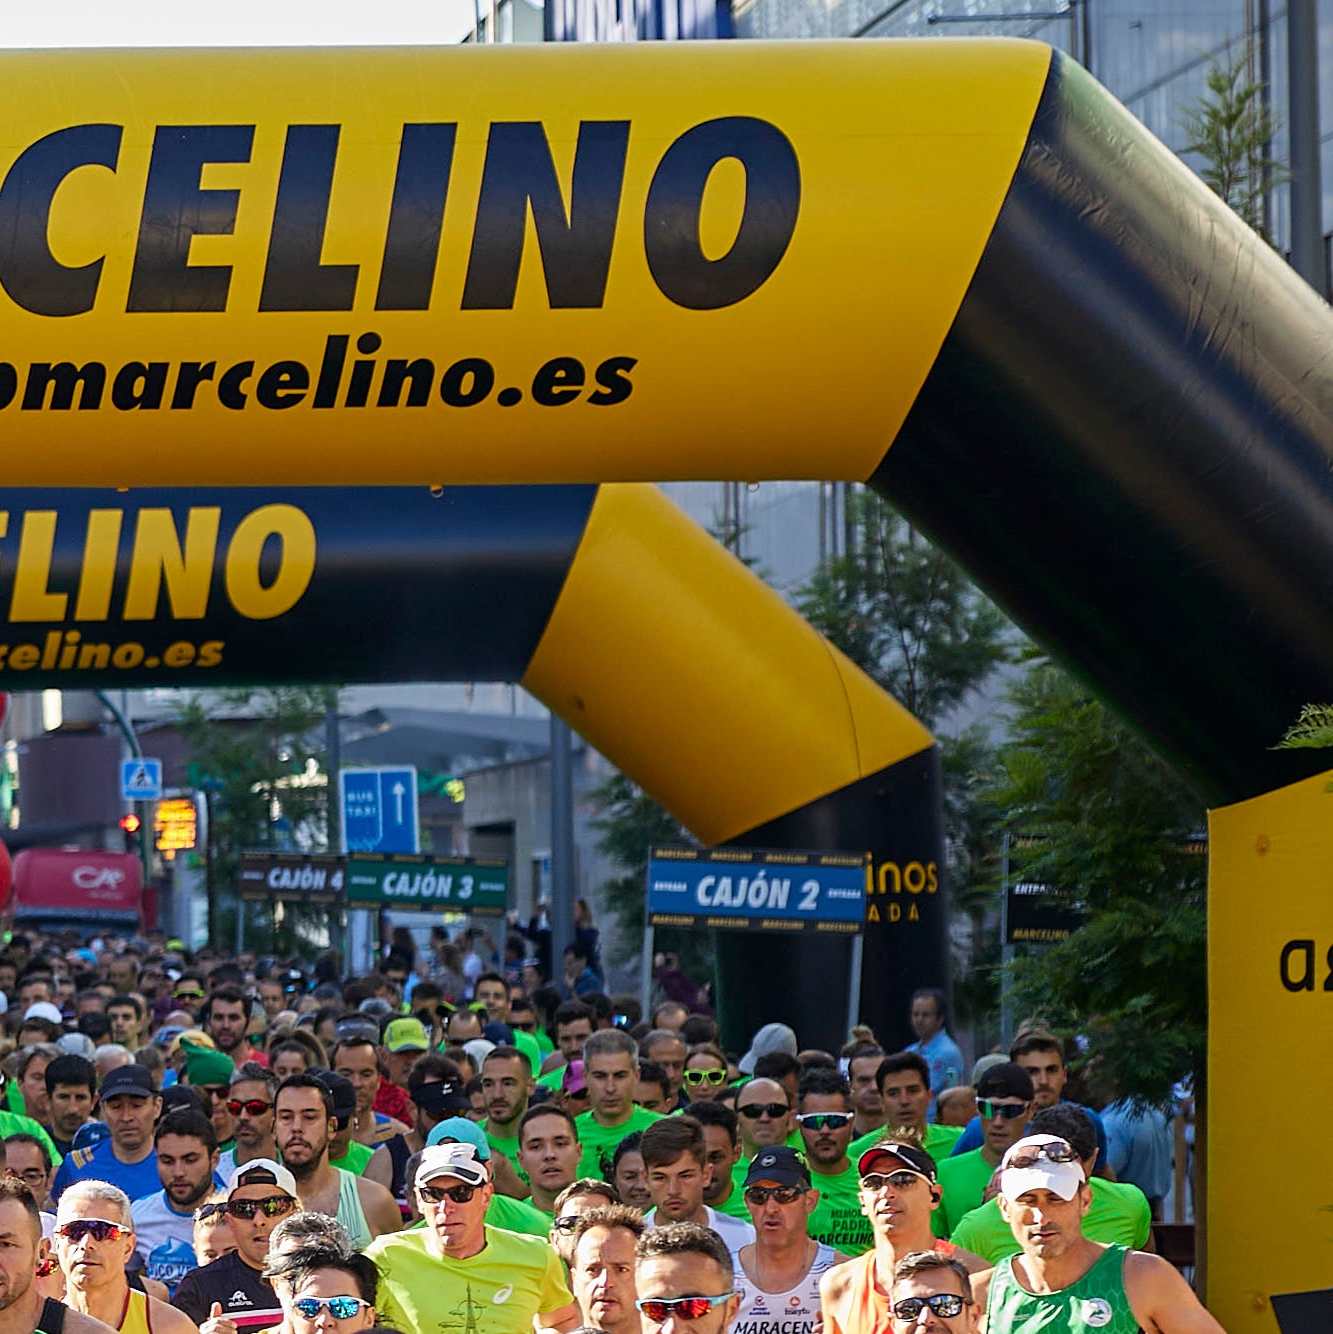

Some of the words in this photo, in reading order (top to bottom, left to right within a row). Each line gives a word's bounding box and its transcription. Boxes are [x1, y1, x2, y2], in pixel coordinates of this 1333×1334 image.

[268, 866, 325, 890] CAJÓN
[331, 871, 345, 891] 4
[383, 868, 453, 898] CAJÓN
[458, 876, 474, 898] 3
[696, 869, 791, 910] CAJÓN
[798, 879, 820, 910] 2
